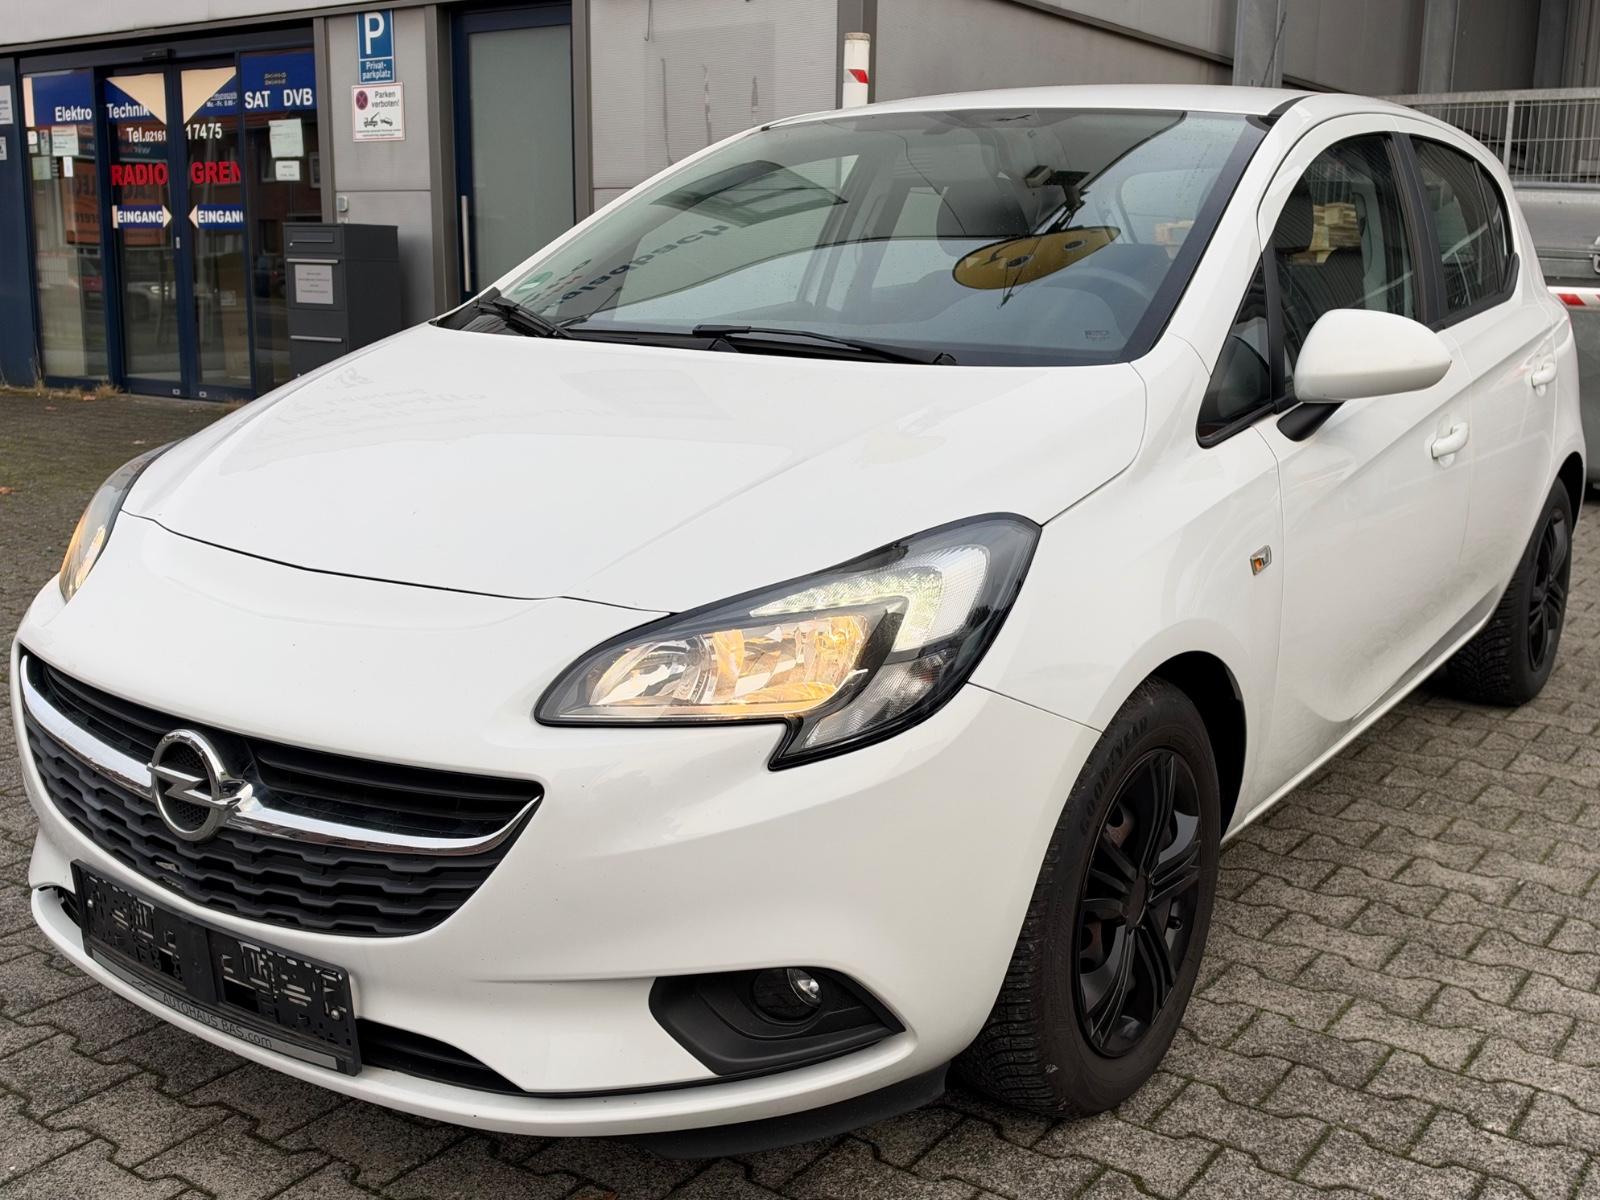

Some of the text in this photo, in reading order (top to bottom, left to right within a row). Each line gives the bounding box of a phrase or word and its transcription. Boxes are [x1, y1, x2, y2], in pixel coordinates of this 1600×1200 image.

[365, 12, 385, 55] P
[366, 61, 387, 70] Privat-
[362, 70, 392, 81] parkplatz
[244, 91, 271, 109] SAT
[283, 88, 313, 107] DVB
[374, 90, 396, 99] Parken
[54, 105, 92, 122] Elektro
[185, 122, 222, 140] 17475
[111, 163, 168, 186] RADIO
[117, 210, 163, 223] EINGANG
[163, 992, 218, 1028] AUTOHAUS
